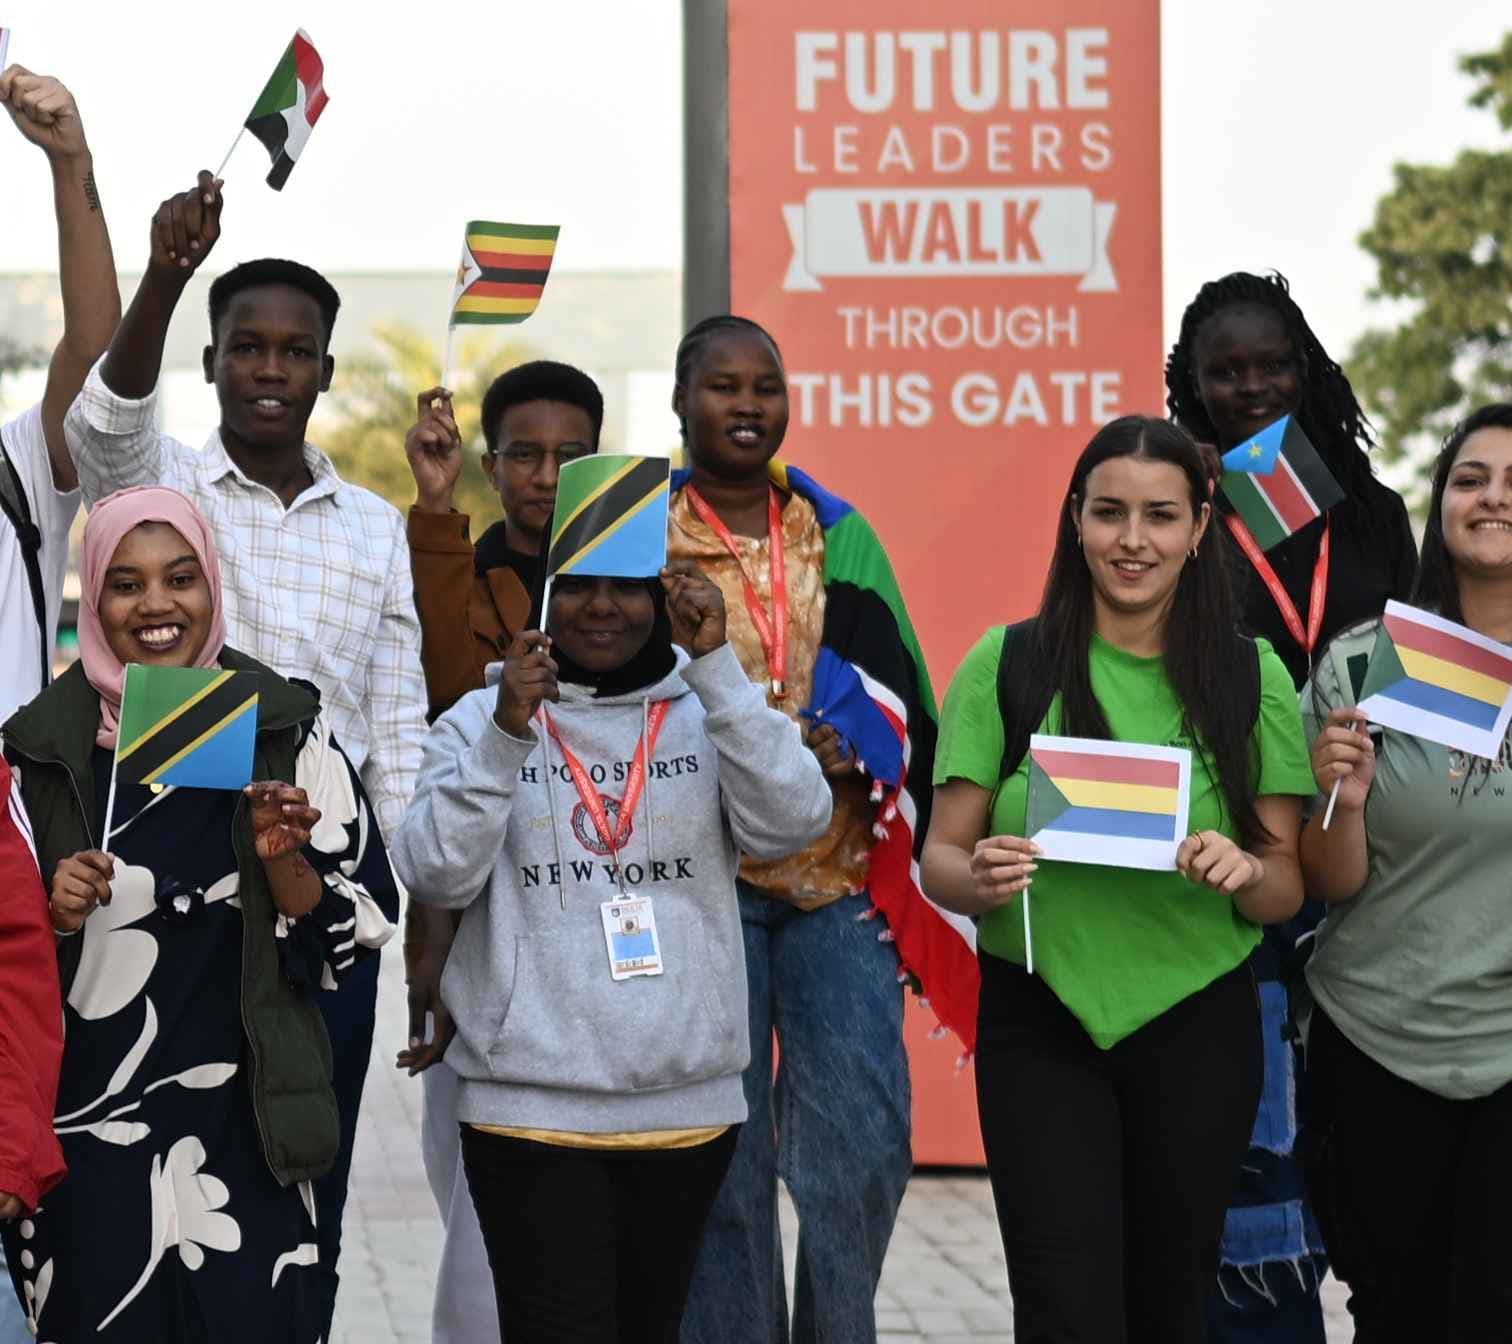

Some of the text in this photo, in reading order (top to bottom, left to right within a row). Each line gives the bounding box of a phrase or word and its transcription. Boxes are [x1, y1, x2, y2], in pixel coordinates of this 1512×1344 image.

[794, 28, 1109, 114] FUTURE
[794, 123, 1113, 172] LEADERS
[857, 198, 1042, 264] WALK
[838, 306, 1079, 349] THROUGH
[788, 371, 1121, 427] THIS GATE
[1451, 786, 1505, 798] NEW
[520, 857, 694, 887] NEW YORK
